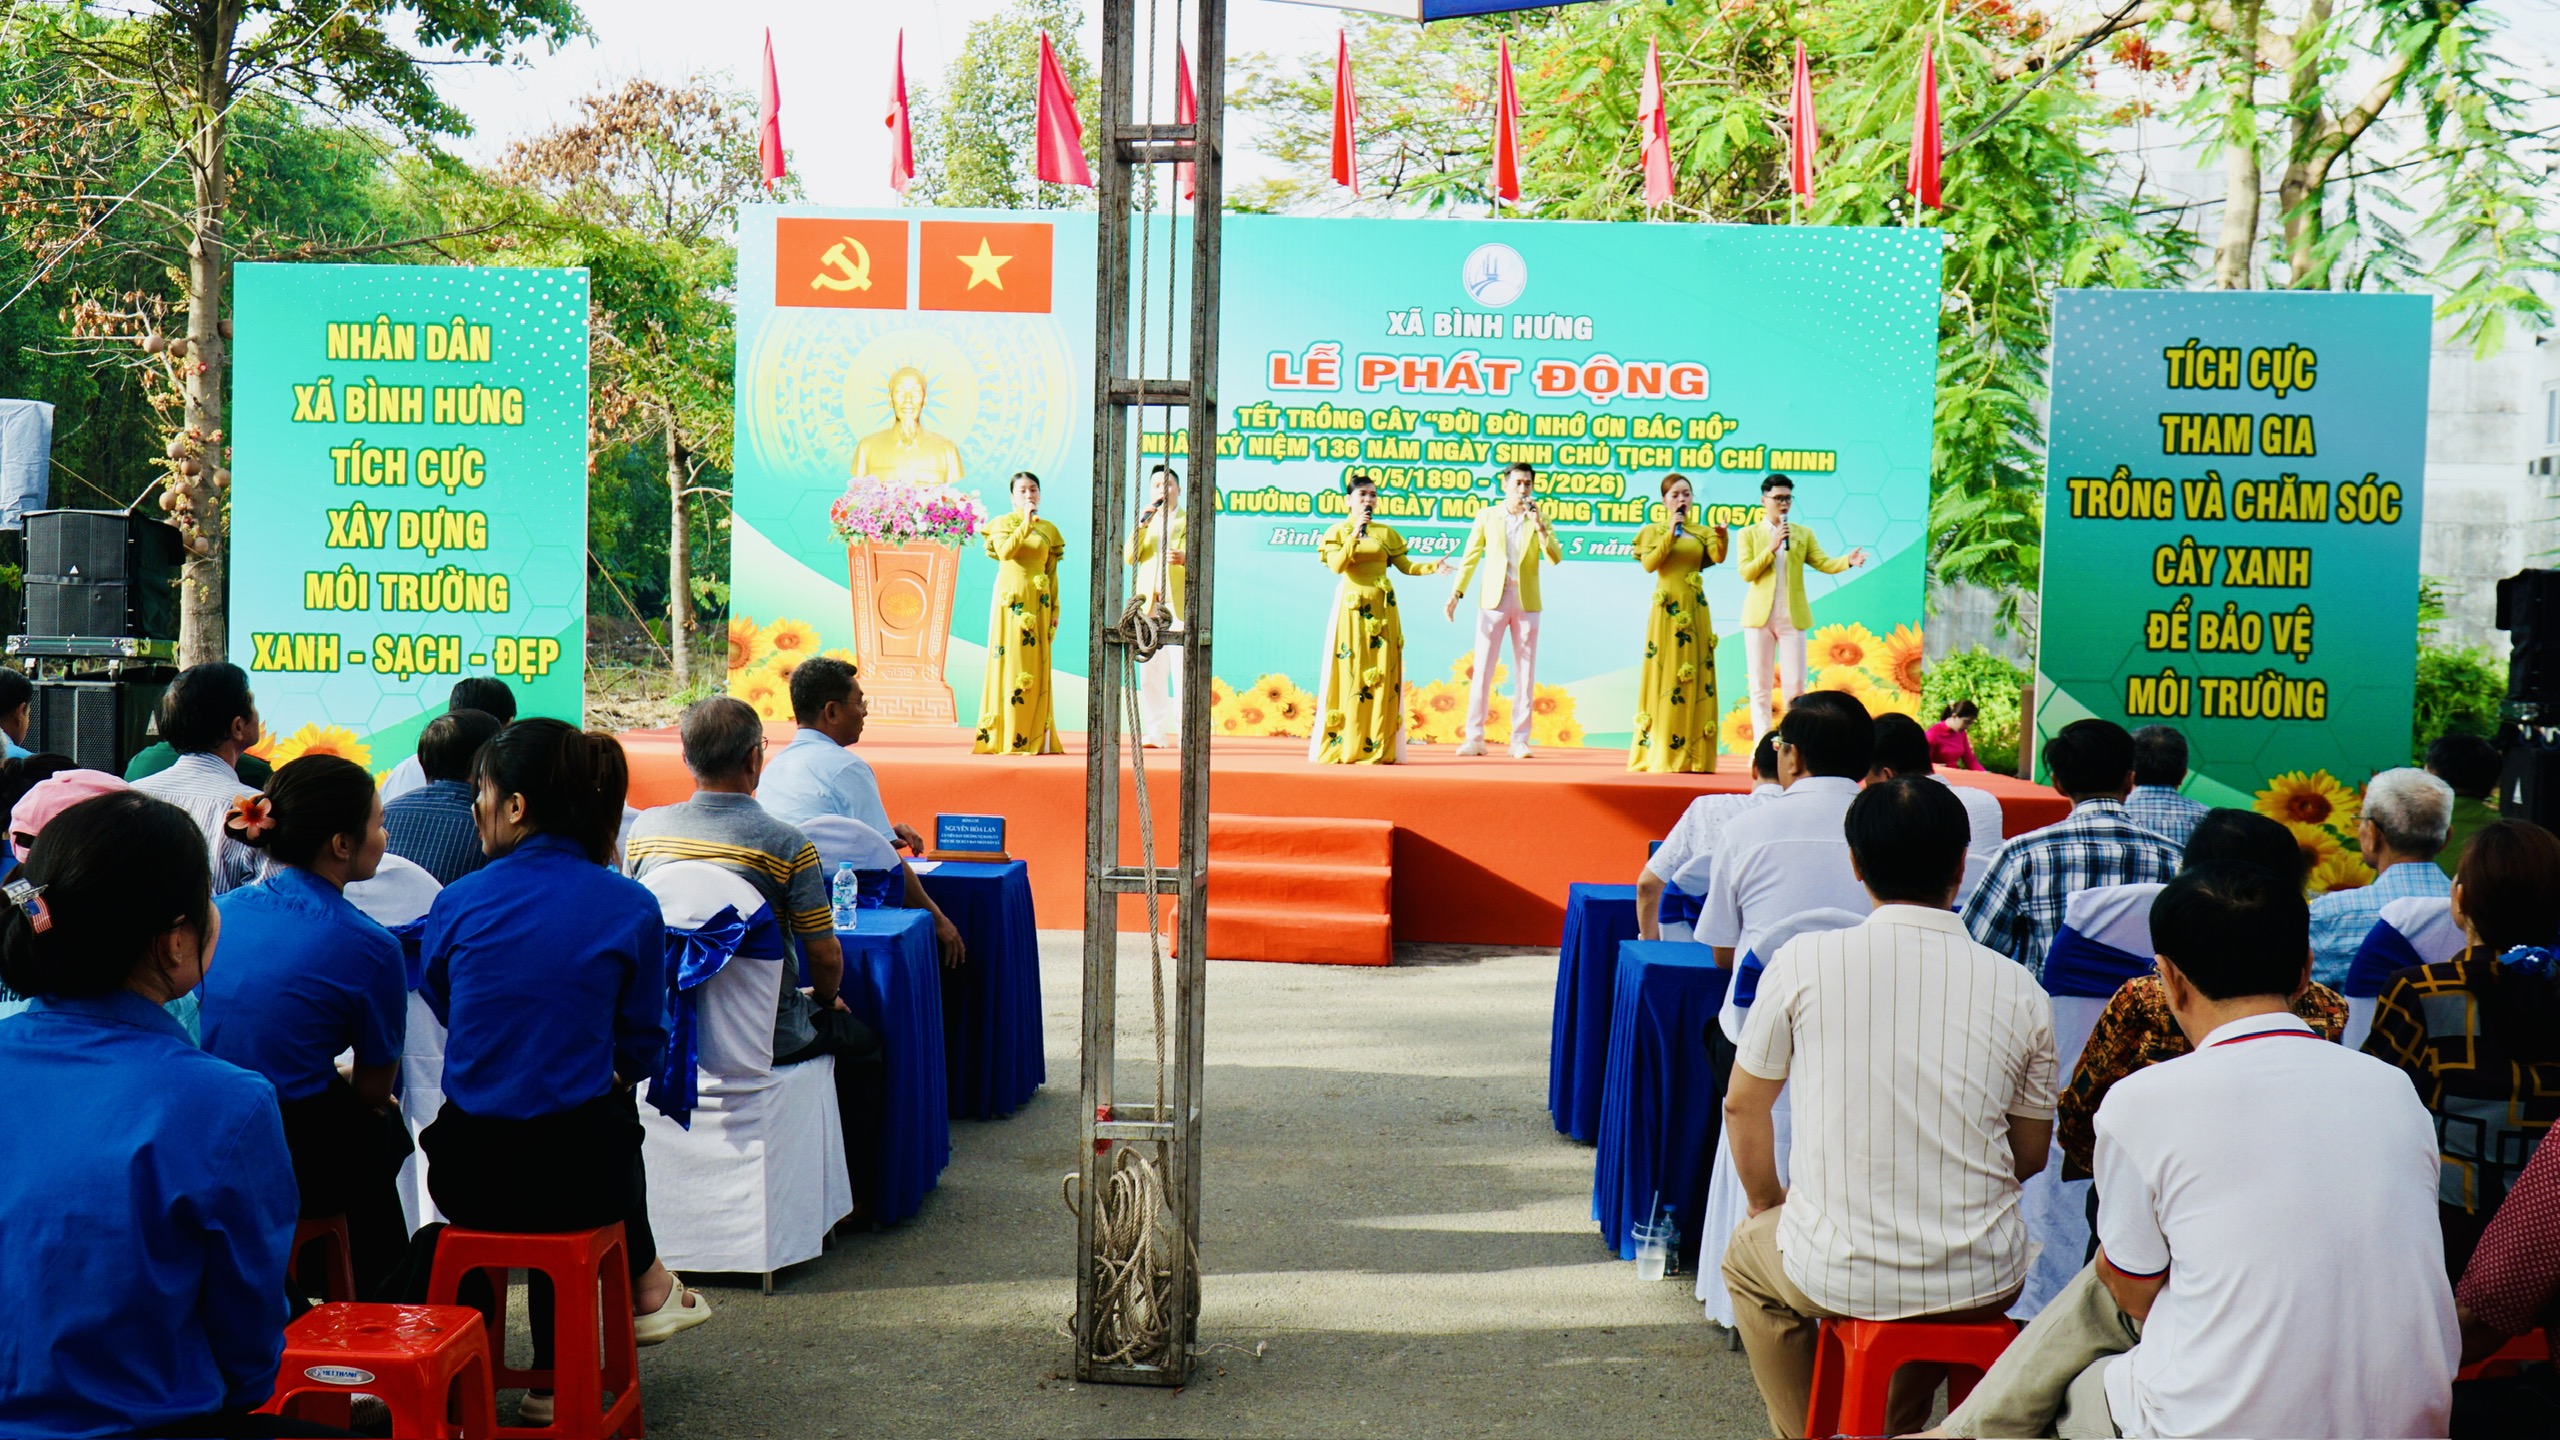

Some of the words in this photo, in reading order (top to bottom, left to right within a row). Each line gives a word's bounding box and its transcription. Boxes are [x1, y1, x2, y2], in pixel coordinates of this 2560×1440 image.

[328, 315, 415, 360] NHÂN
[427, 317, 491, 362] DÂN
[1387, 308, 1424, 336] XÃ
[1434, 309, 1502, 338] BÌNH
[1513, 314, 1593, 340] HƯNG
[1273, 347, 1337, 386] LỄ
[1361, 355, 1518, 391] PHÁT
[1536, 358, 1705, 401] ĐỘNG
[2166, 340, 2239, 388] TÍCH
[2250, 345, 2315, 397] CỰC
[294, 377, 336, 422] XÃ
[346, 378, 423, 423] BÌNH
[434, 384, 523, 425] HƯNG
[1239, 403, 1280, 427] TẾT
[1286, 404, 1364, 430] TRỒNG
[1371, 408, 1418, 431] CÂY
[1425, 410, 1480, 434] “ĐỜI
[1486, 412, 1528, 436] ĐỜI
[1535, 413, 1586, 437] NHỚ
[1592, 416, 1626, 438] ƠN
[1633, 415, 1681, 440] BÁC
[1688, 414, 1737, 441] HỒ”
[1141, 430, 1190, 455] NHÂ
[1216, 430, 1243, 456] KỶ
[1249, 433, 1308, 460] NIỆM
[1317, 439, 1360, 458] 136
[1367, 437, 1420, 460] NĂM
[1427, 439, 1490, 462] NGÀY
[1496, 444, 1553, 464] SINH
[1559, 441, 1610, 466] CHỦ
[1616, 447, 1673, 470] TỊCH
[1680, 443, 1714, 469] HỒ
[1720, 446, 1763, 470] CHÍ
[1770, 451, 1835, 471] MINH
[2161, 415, 2251, 453] THAM
[2262, 416, 2314, 455] GIA
[331, 440, 406, 485] TÍCH
[417, 446, 484, 495] CỰC
[1497, 470, 1625, 498] 15/2026)
[1230, 489, 1311, 513] HƯỞNG
[1317, 490, 1352, 514] ỨN
[1375, 493, 1437, 516] NGÀY
[1597, 498, 1647, 523] THẾ
[1649, 503, 1700, 524] GI
[1707, 505, 1767, 527] (05/6
[2069, 467, 2173, 518] TRỒNG
[2184, 473, 2224, 519] VÀ
[2234, 476, 2327, 520] CHĂM
[2338, 475, 2400, 522] SÓC
[328, 502, 390, 548] XÂY
[399, 507, 487, 557] DỰNG
[1269, 528, 1323, 546] Bình
[1408, 532, 1461, 554] ngày
[1569, 537, 1584, 555] 5
[2156, 537, 2217, 585] CÂY
[2225, 549, 2309, 586] XANH
[306, 565, 368, 610] MÔI
[378, 567, 508, 612] TRƯỜNG
[2147, 597, 2190, 649] ĐỂ
[2199, 603, 2261, 651] BẢO
[2272, 607, 2311, 661] VỆ
[253, 634, 339, 671] XANH
[349, 653, 364, 663] -
[374, 635, 460, 681] SẠCH
[470, 655, 485, 665] -
[493, 637, 559, 683] ĐẸP
[2128, 669, 2189, 716] MÔI
[2200, 671, 2325, 718] TRƯỜNG
